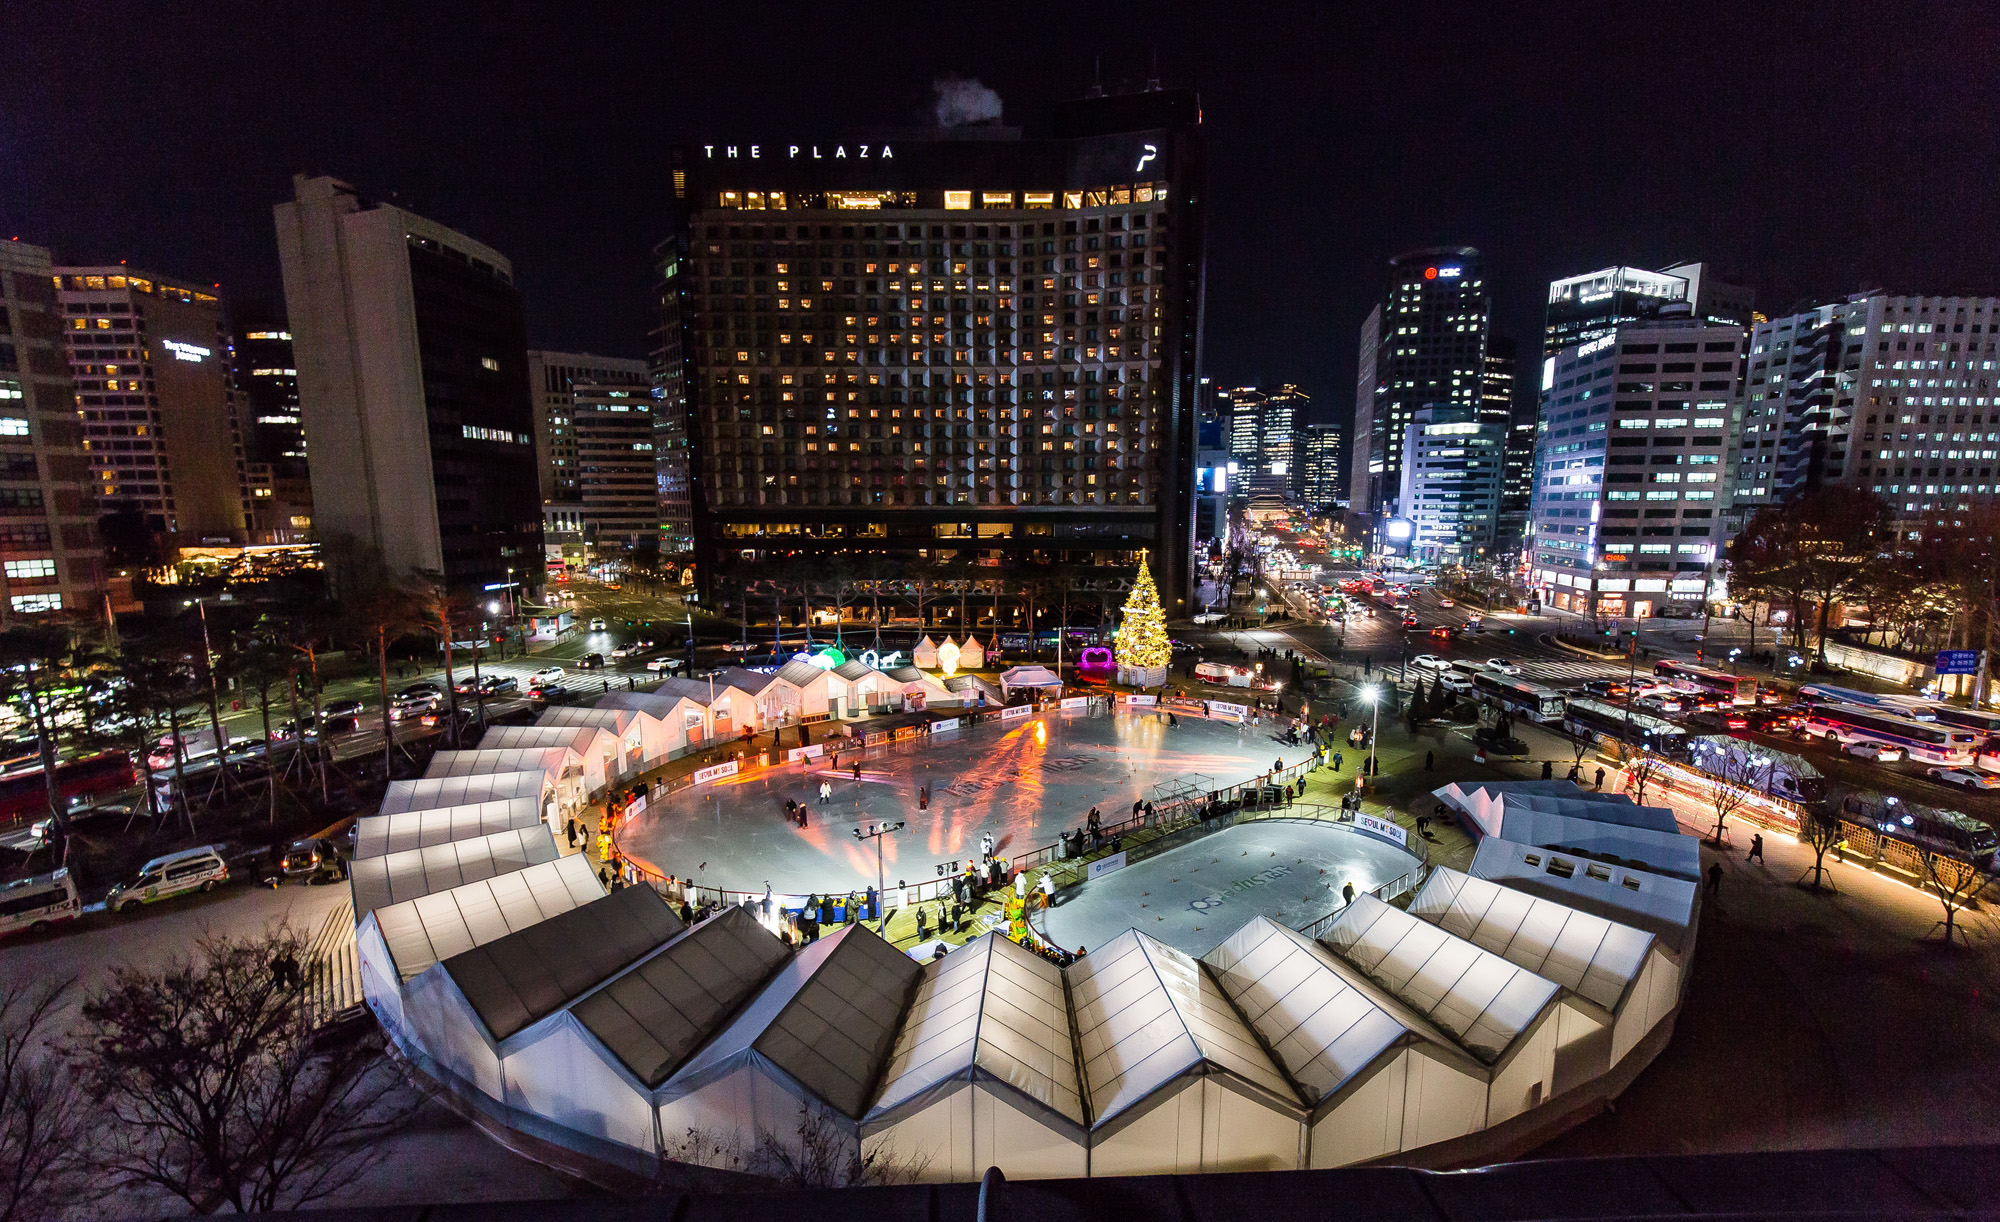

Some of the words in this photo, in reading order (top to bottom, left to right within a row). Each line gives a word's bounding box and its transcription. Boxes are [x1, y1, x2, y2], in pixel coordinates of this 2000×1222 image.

[704, 145, 760, 158] THE
[789, 145, 893, 158] PLAZA
[1910, 740, 1927, 749] POLICE
[698, 769, 712, 780] SEOUL
[1360, 816, 1379, 830] SEOUL
[1389, 826, 1402, 840] SOUL
